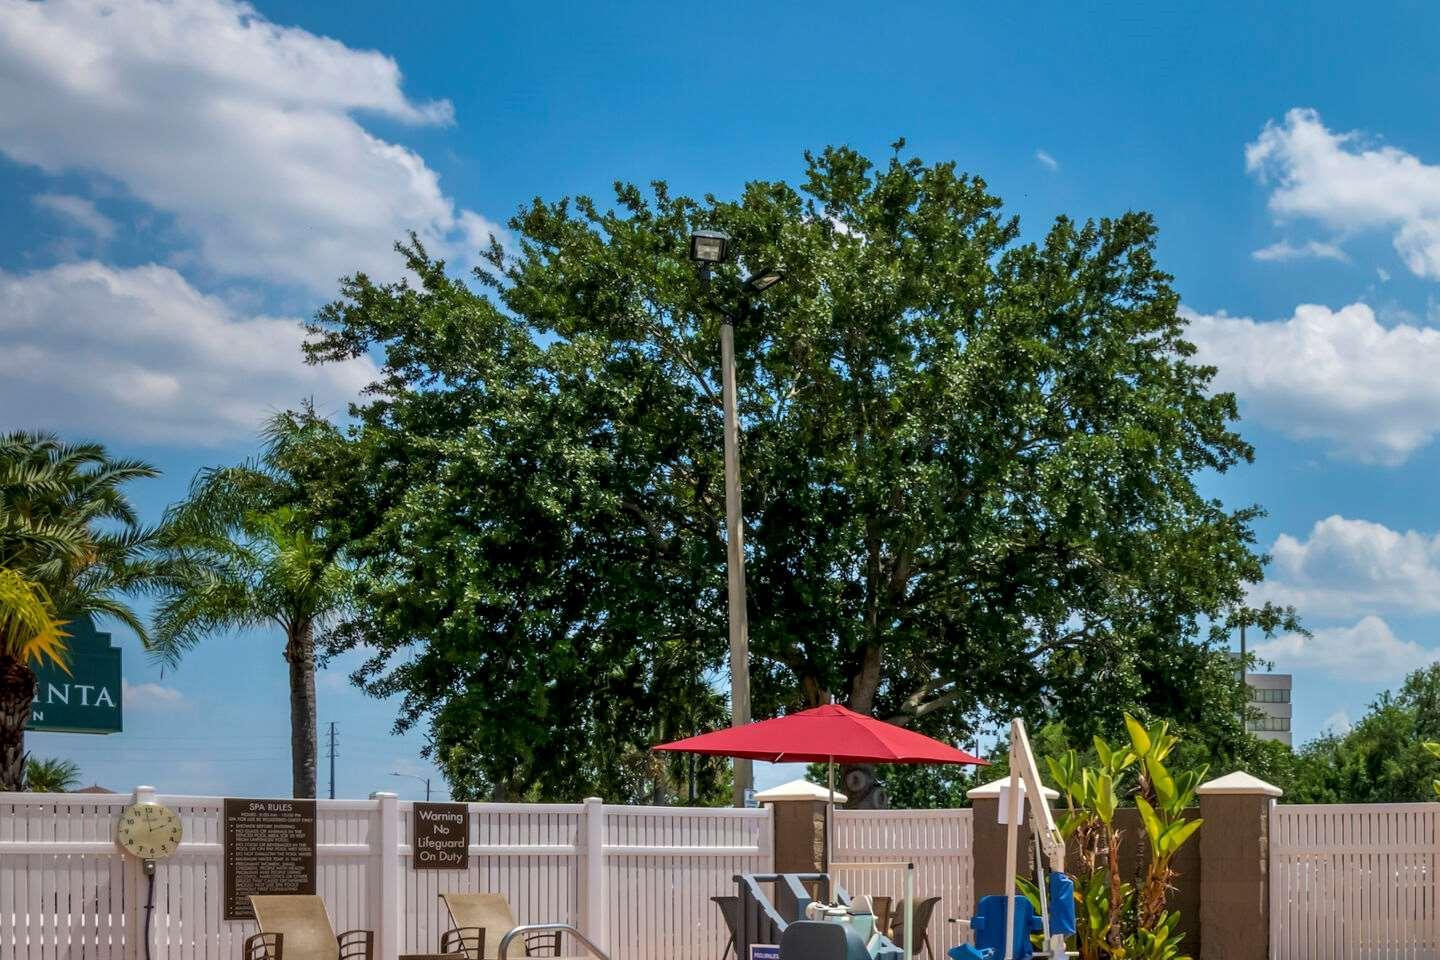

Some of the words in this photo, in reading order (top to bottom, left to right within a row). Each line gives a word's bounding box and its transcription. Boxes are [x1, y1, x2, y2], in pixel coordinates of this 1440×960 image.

[33, 682, 115, 707] INTA
[249, 803, 266, 811] SPA
[267, 803, 293, 811] RULES
[419, 811, 463, 824] Warning
[433, 825, 450, 834] No
[418, 836, 465, 850] Lifeguard
[420, 851, 436, 861] On
[439, 851, 463, 864] Duty
